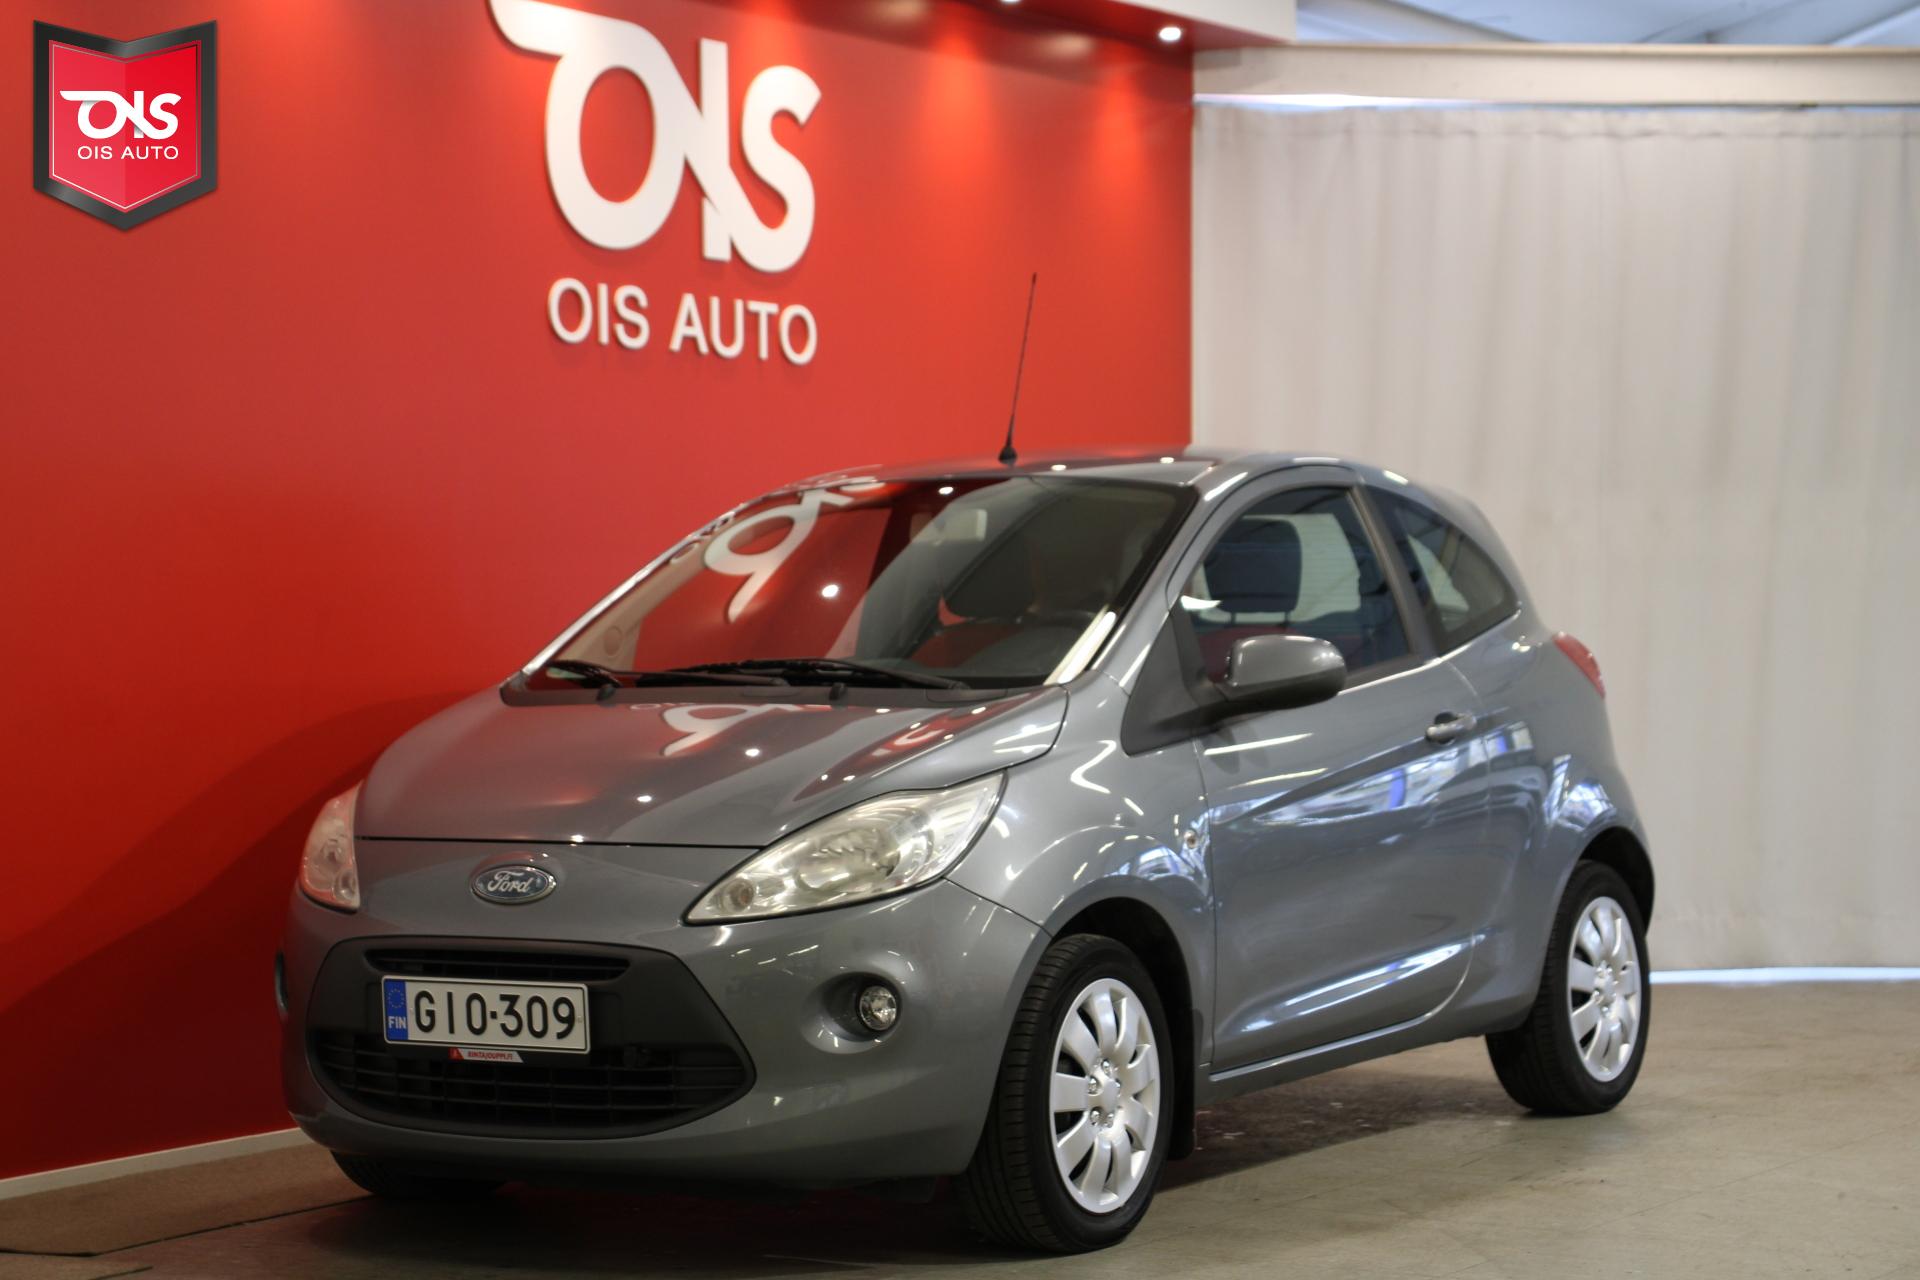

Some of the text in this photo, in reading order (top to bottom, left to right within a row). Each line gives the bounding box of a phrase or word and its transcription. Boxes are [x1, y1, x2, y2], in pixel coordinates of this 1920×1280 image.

[547, 277, 818, 366] OIS AUTO
[487, 870, 535, 893] Ford
[388, 1016, 408, 1030] FIN
[414, 990, 576, 1041] GIO-309
